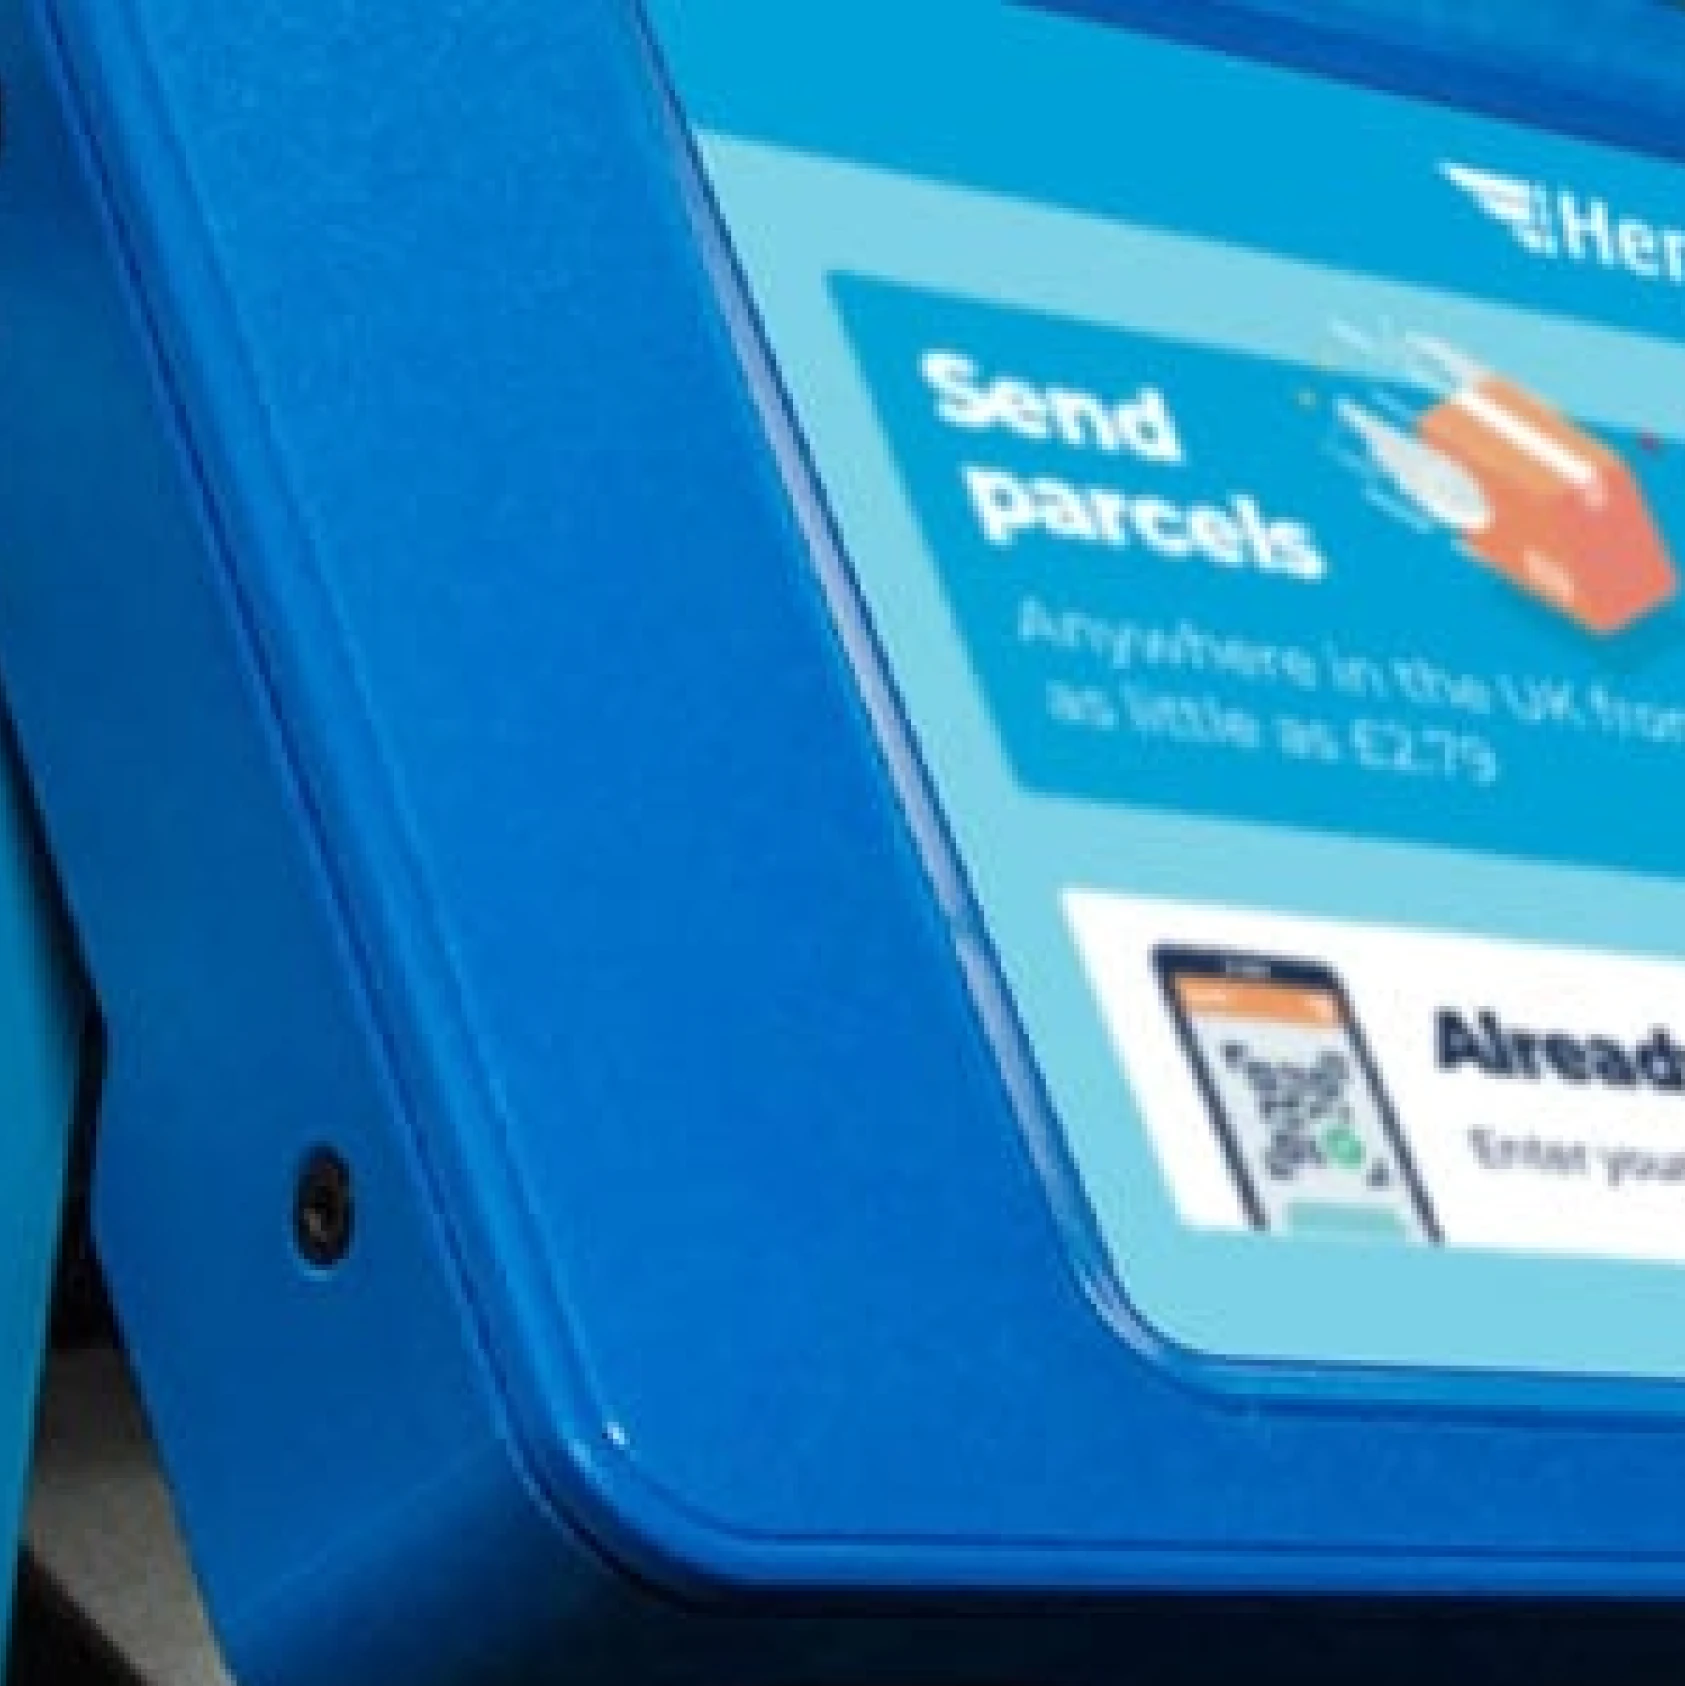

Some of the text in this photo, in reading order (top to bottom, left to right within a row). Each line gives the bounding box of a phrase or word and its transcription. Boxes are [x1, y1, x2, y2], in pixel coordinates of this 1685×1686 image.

[918, 346, 1183, 464] Send
[963, 462, 1328, 582] parcels
[1016, 596, 1317, 690] Anywhere
[1324, 640, 1386, 697] in
[1392, 656, 1493, 715] the
[1497, 674, 1576, 724] UK
[1045, 678, 1119, 731] as
[1120, 682, 1262, 750] little
[1278, 713, 1340, 763] as
[1467, 1122, 1592, 1180] Enter
